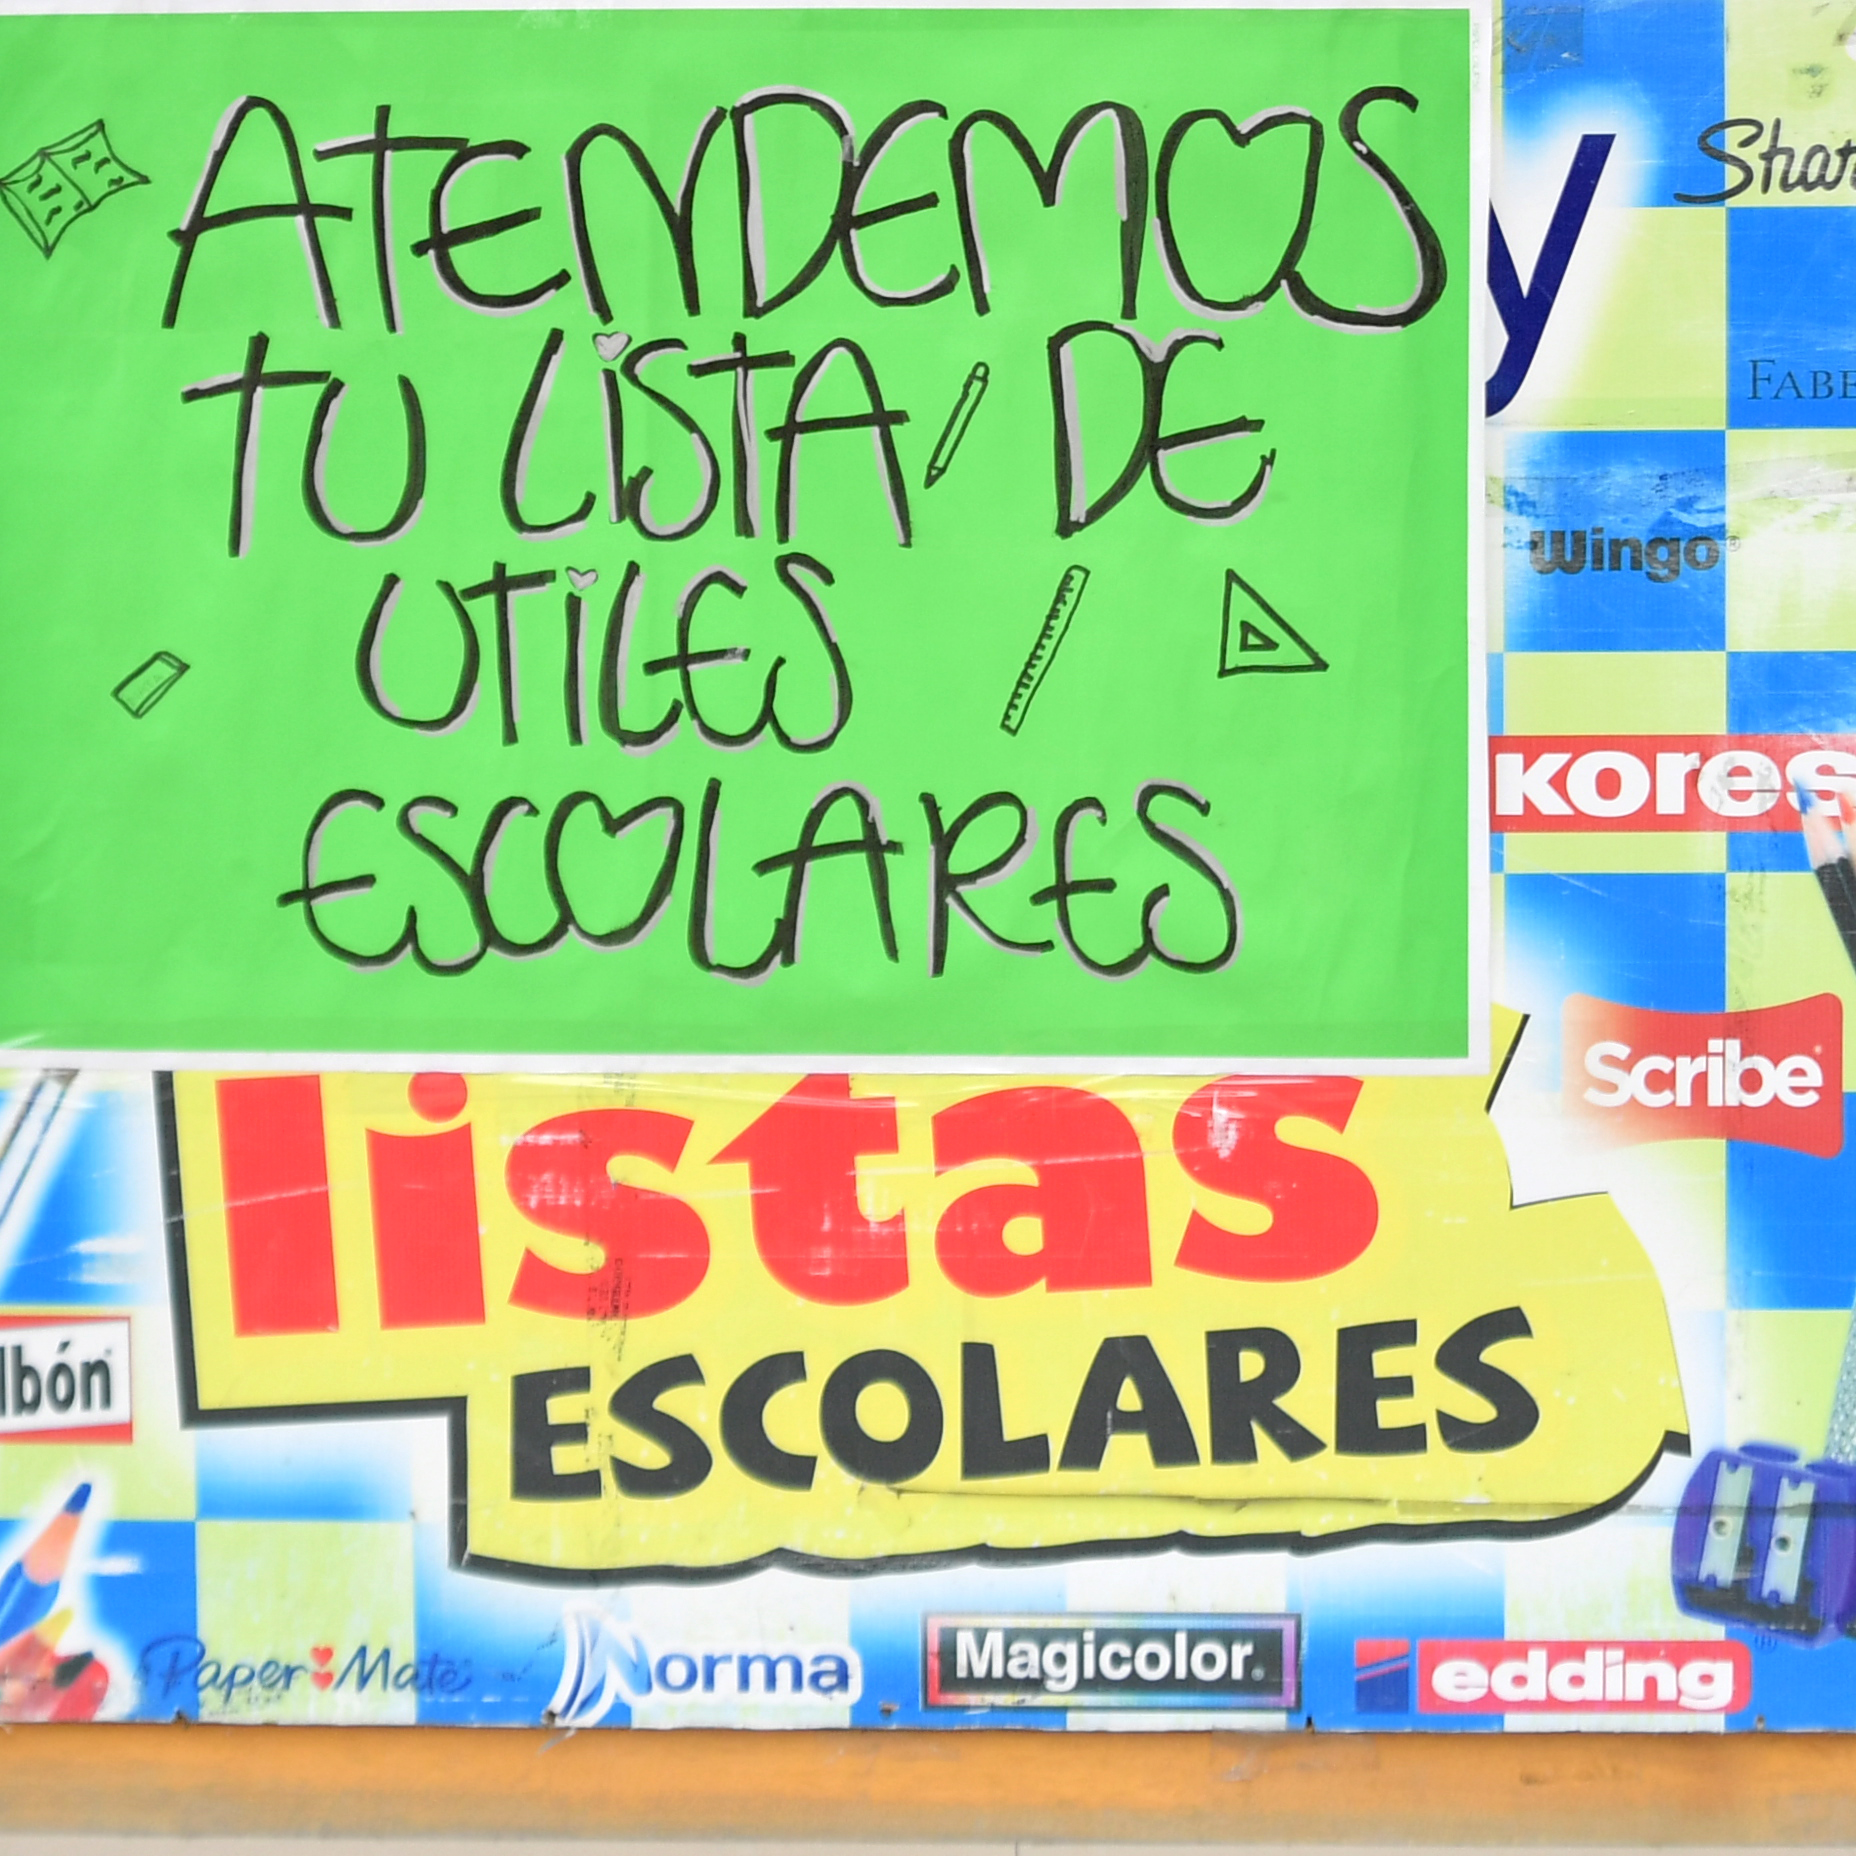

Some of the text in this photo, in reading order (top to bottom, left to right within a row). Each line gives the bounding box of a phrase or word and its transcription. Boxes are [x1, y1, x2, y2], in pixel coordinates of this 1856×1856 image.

[161, 85, 1447, 334] ATENDEMOS
[181, 332, 427, 558] TU
[1048, 320, 1276, 539] DE
[1530, 527, 1720, 583] Wingo
[276, 778, 1243, 986] ESCOLARES
[1583, 1039, 1822, 1108] Scribe
[215, 1072, 1379, 1338] listas
[510, 1305, 1540, 1502] ESCOLARES
[552, 1610, 852, 1724] Norma
[1431, 1648, 1734, 1709] edding
